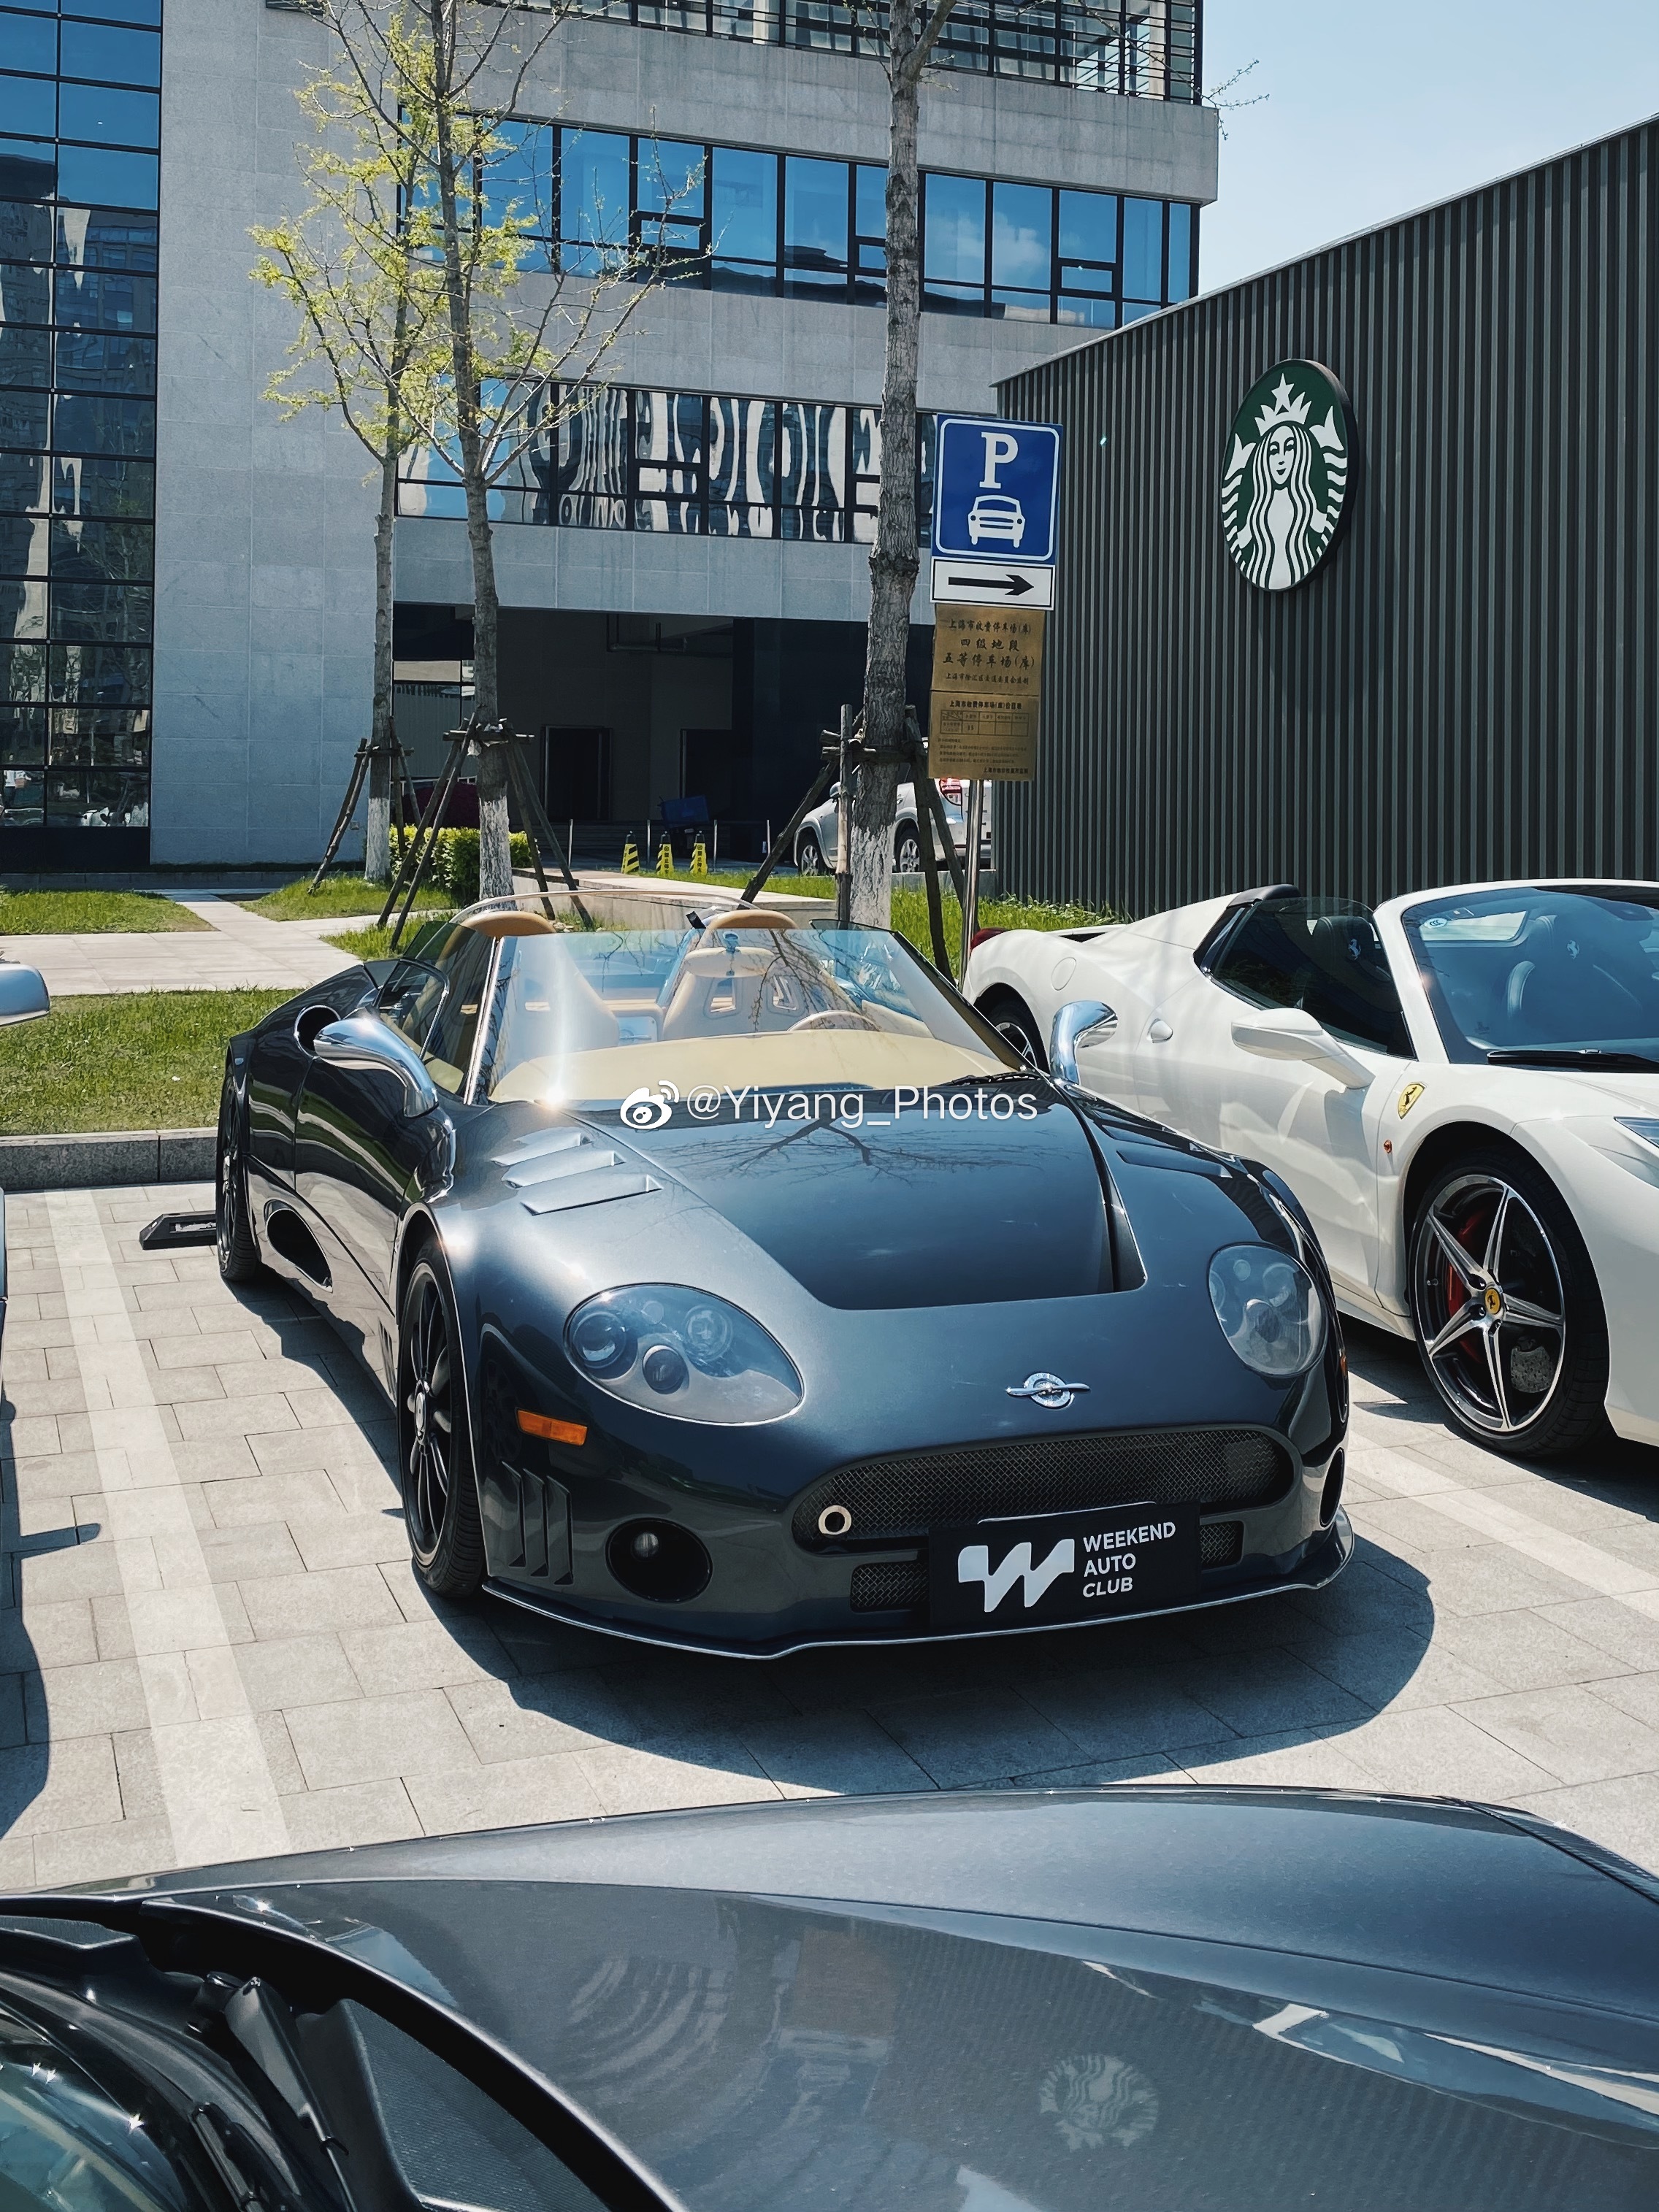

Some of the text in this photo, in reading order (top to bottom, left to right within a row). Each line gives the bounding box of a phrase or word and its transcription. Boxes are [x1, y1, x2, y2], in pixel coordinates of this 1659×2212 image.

[979, 432, 1018, 488] P
[960, 638, 1019, 652] 四级地段
[1083, 1521, 1176, 1553] WEEKEND
[1084, 1553, 1136, 1578] AUTO
[1082, 1577, 1133, 1598] CLUB
